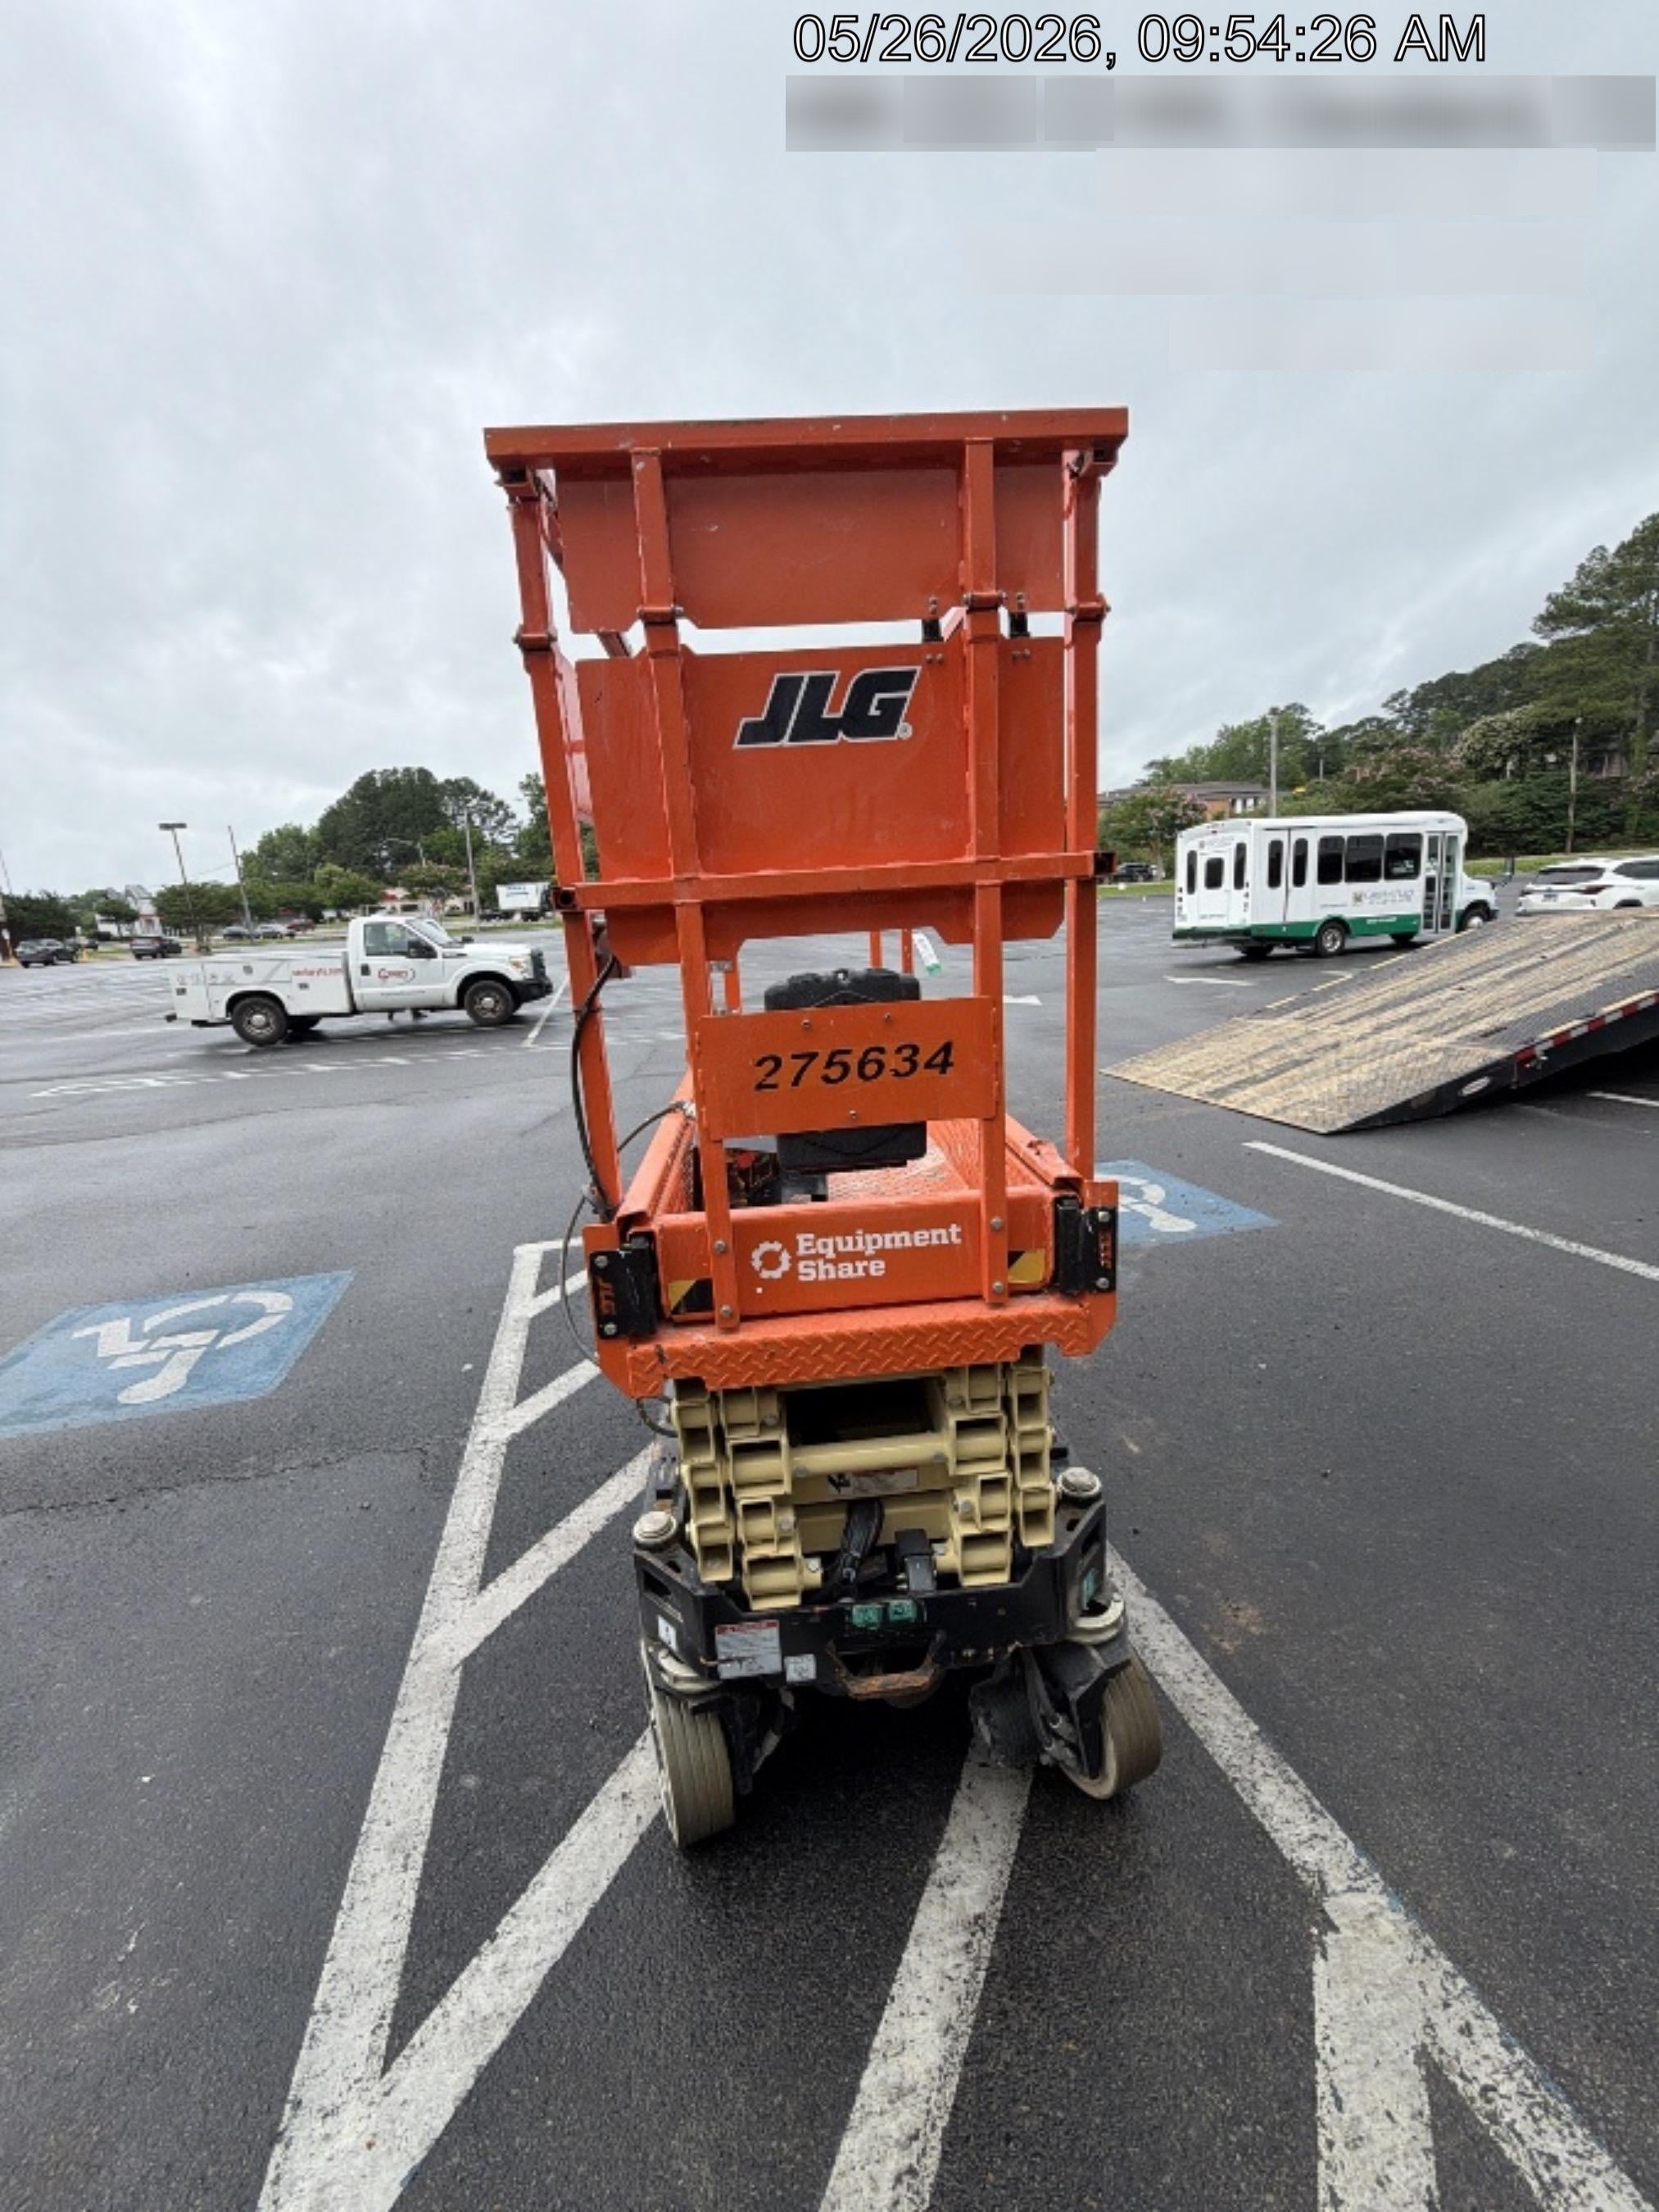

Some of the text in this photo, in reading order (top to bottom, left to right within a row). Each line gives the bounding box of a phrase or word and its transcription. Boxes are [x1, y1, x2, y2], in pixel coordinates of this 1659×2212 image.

[732, 666, 922, 750] JLG
[754, 1040, 955, 1091] 275634
[796, 1223, 963, 1259] Equipment
[797, 1258, 886, 1281] Share
